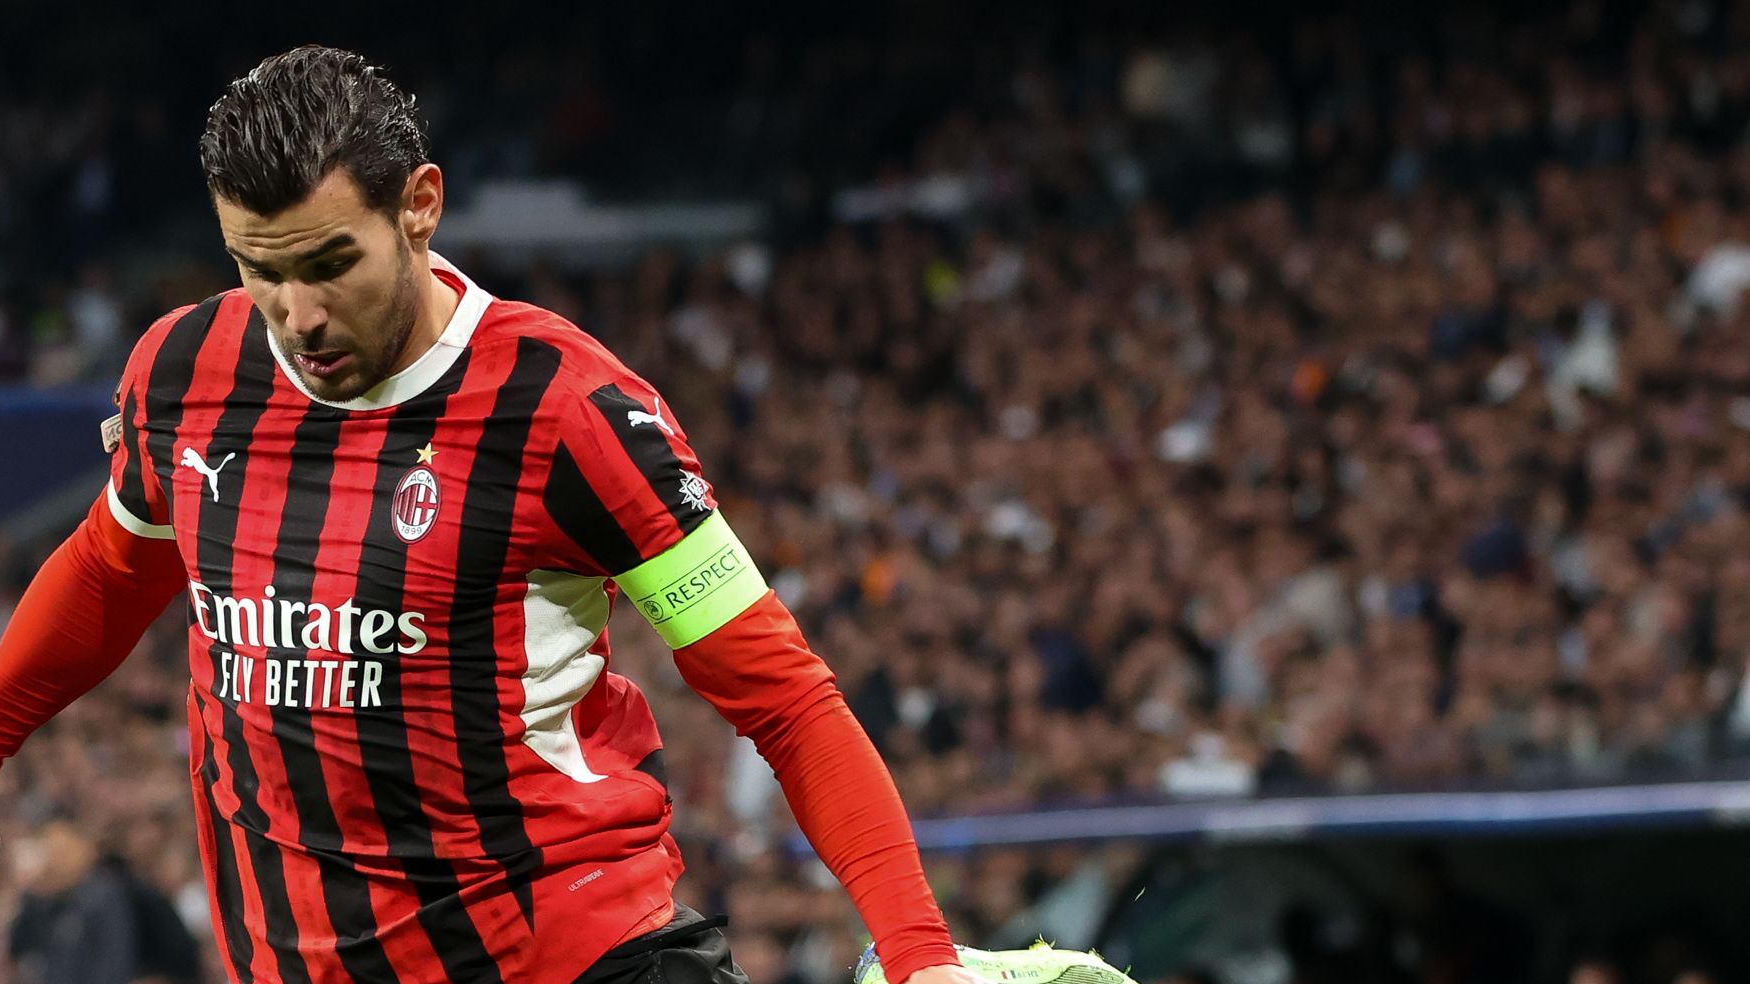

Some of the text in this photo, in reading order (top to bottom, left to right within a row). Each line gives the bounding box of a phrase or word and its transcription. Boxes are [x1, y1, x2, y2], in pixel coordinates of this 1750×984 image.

[407, 471, 433, 487] ACM
[400, 525, 423, 535] 1899
[665, 549, 742, 610] RESPECT
[188, 579, 428, 655] Emirates
[219, 651, 384, 708] FLY BETTER
